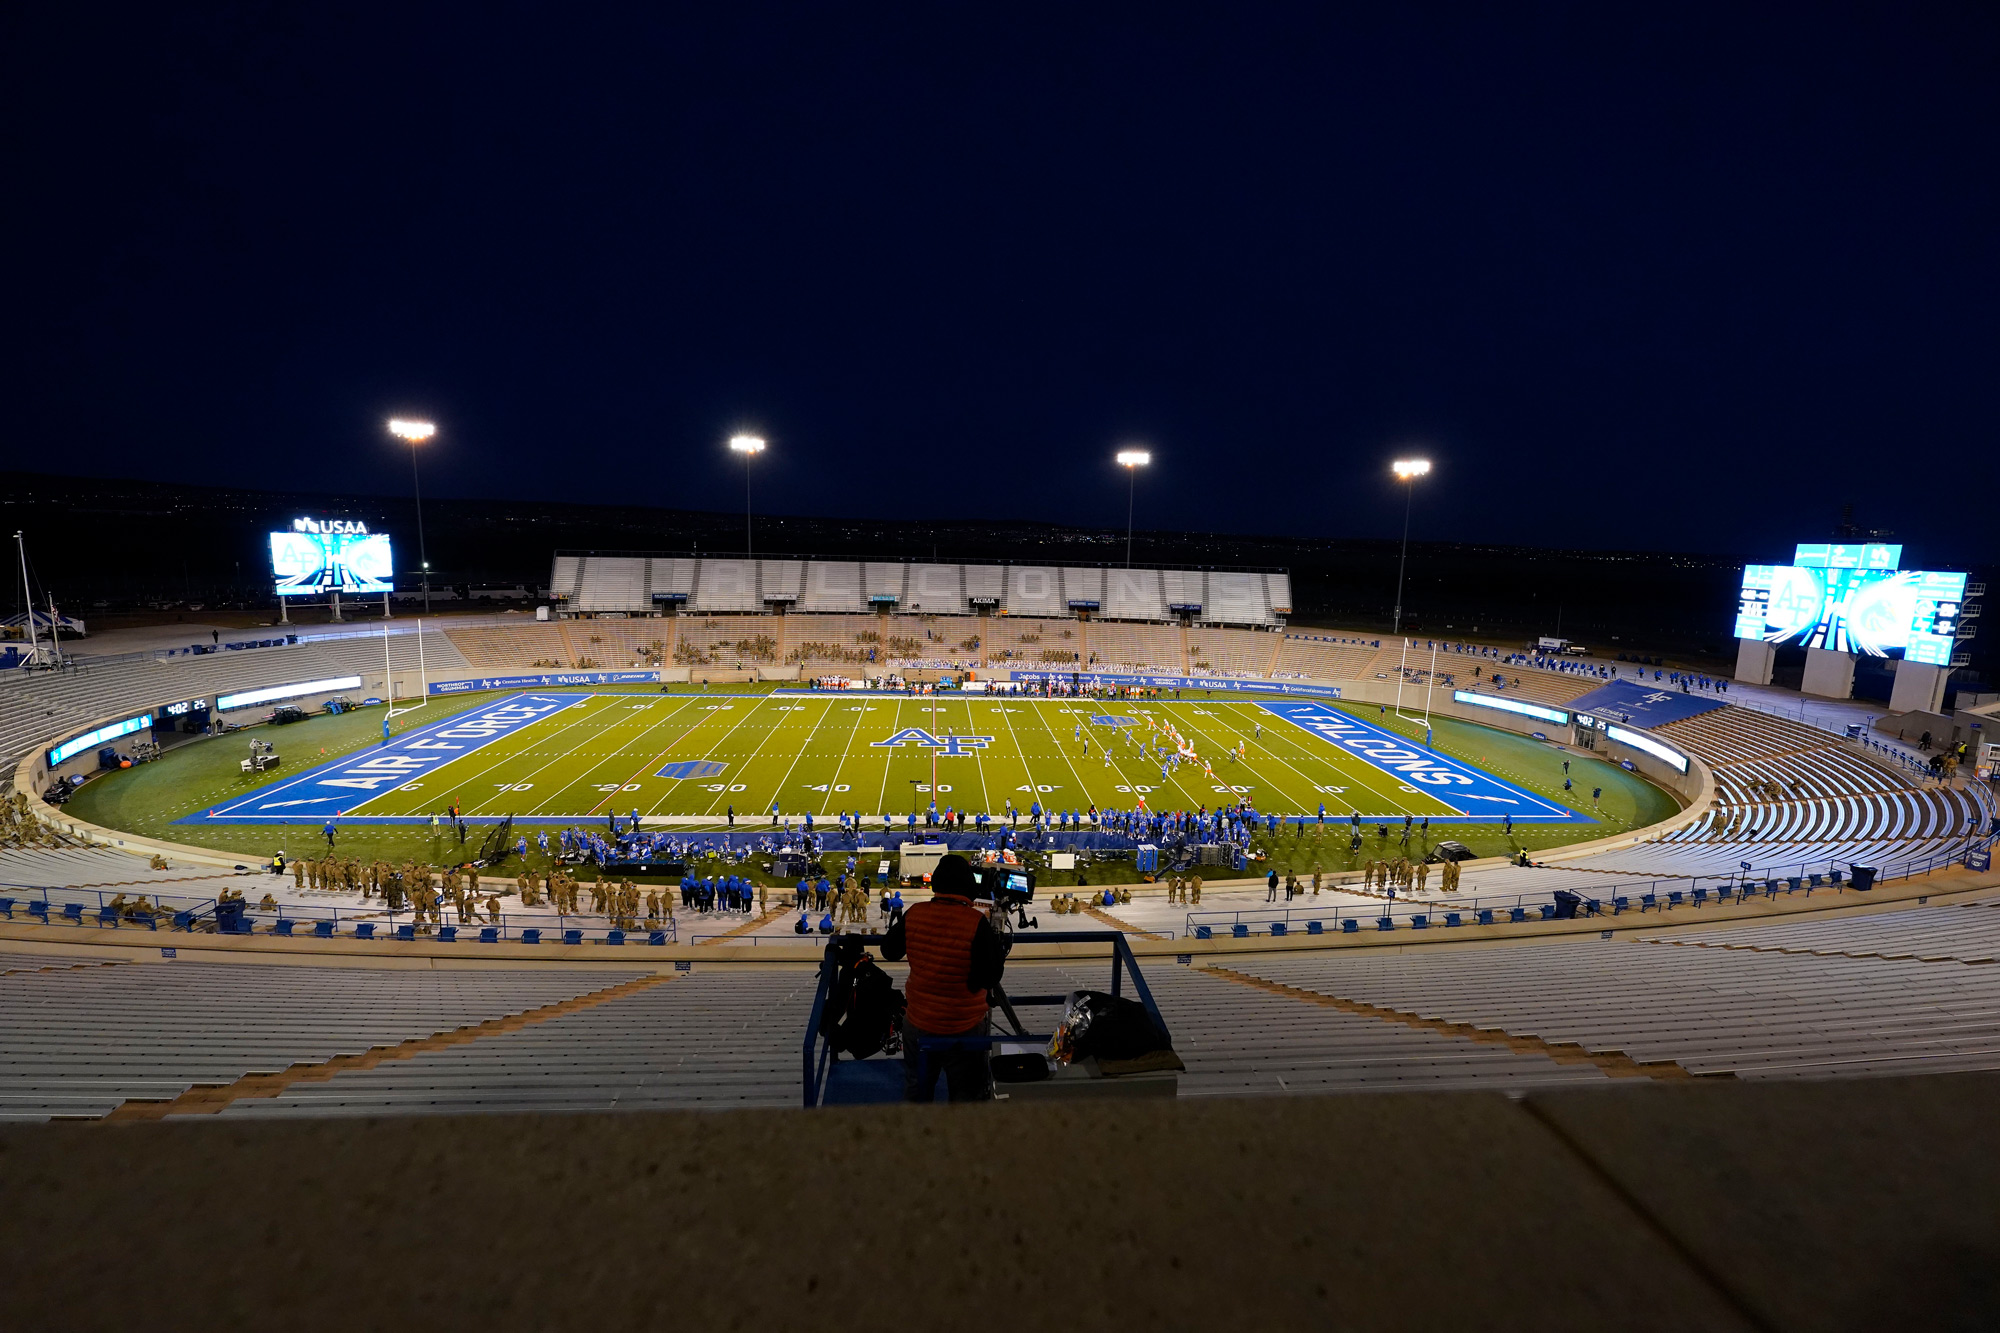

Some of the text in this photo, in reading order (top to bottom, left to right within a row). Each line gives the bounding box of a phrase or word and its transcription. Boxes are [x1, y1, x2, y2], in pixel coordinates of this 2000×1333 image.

[320, 520, 367, 534] USAA
[1773, 579, 1816, 627] AF
[541, 675, 550, 685] AF
[598, 673, 607, 682] AF
[1139, 676, 1147, 685] AF
[482, 679, 491, 689] AF
[1186, 678, 1194, 687] AF
[1208, 681, 1227, 689] USAA
[1233, 681, 1241, 690] AF
[1282, 684, 1290, 693] AF
[1290, 686, 1331, 695] GoAirForceFalcons.com
[1332, 688, 1340, 697] AF
[167, 699, 206, 715] 4:02 25
[1577, 714, 1594, 727] 4:02
[1597, 720, 1606, 731] 25
[316, 703, 557, 789] AIR FORCE
[869, 728, 996, 756] AF
[1292, 715, 1474, 785] FALCONS
[598, 783, 642, 792] 20
[706, 784, 747, 792] 30
[811, 784, 851, 792] 40
[915, 784, 953, 793] 50
[1016, 785, 1055, 793] 40
[1114, 785, 1153, 793] 30
[1210, 785, 1250, 793] 20
[1314, 785, 1342, 793] 10
